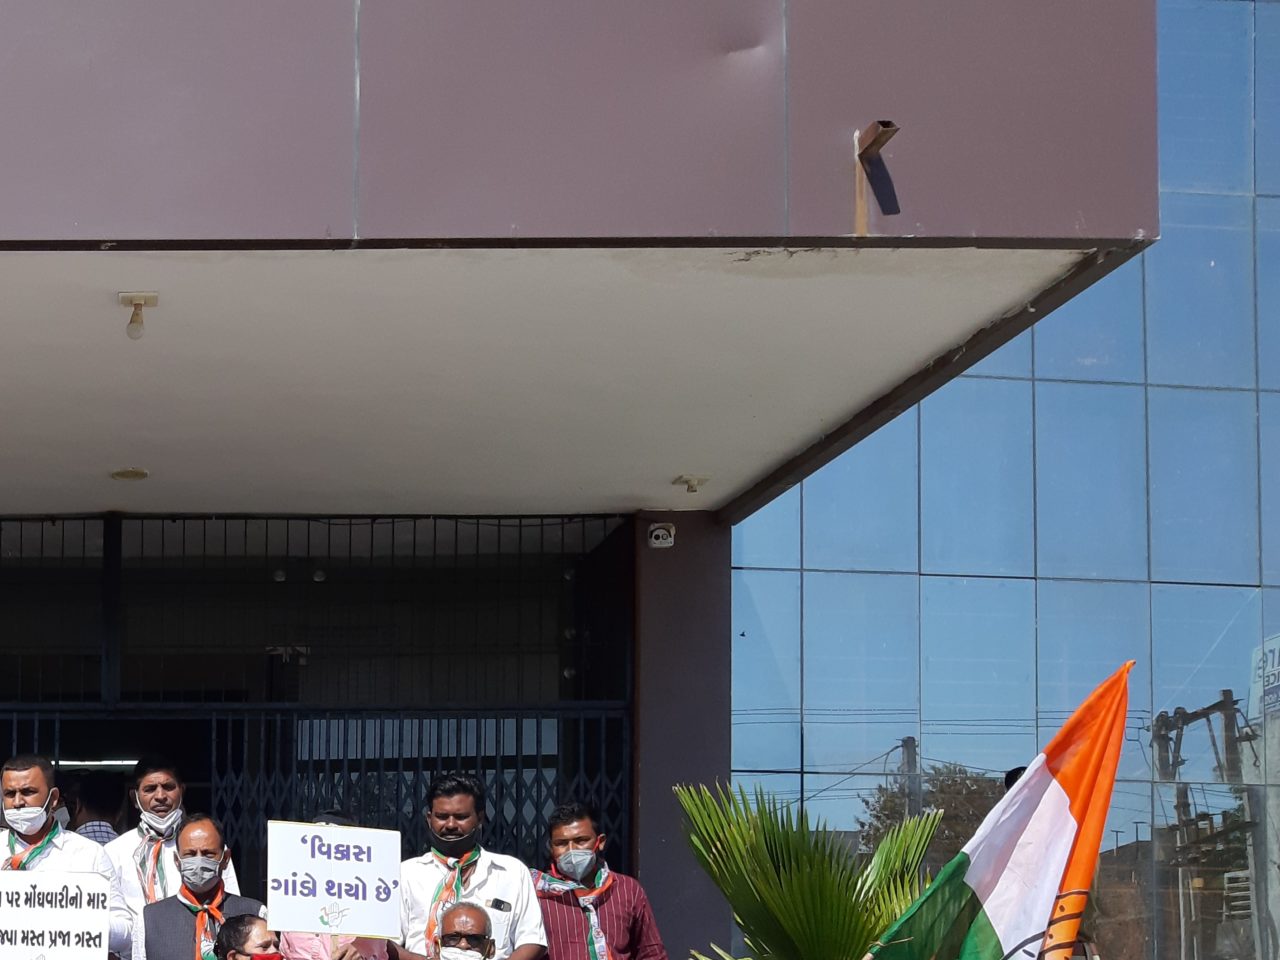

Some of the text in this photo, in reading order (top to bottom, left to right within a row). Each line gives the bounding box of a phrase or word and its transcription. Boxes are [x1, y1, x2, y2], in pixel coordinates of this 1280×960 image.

[5, 891, 21, 908] પર
[24, 884, 83, 909] મોંઘવારીનો
[86, 892, 107, 910] માર
[270, 872, 317, 898] ગાંડો
[325, 876, 367, 901] થયો
[21, 929, 45, 946] મસ્ત
[49, 930, 71, 949] પ્રજા
